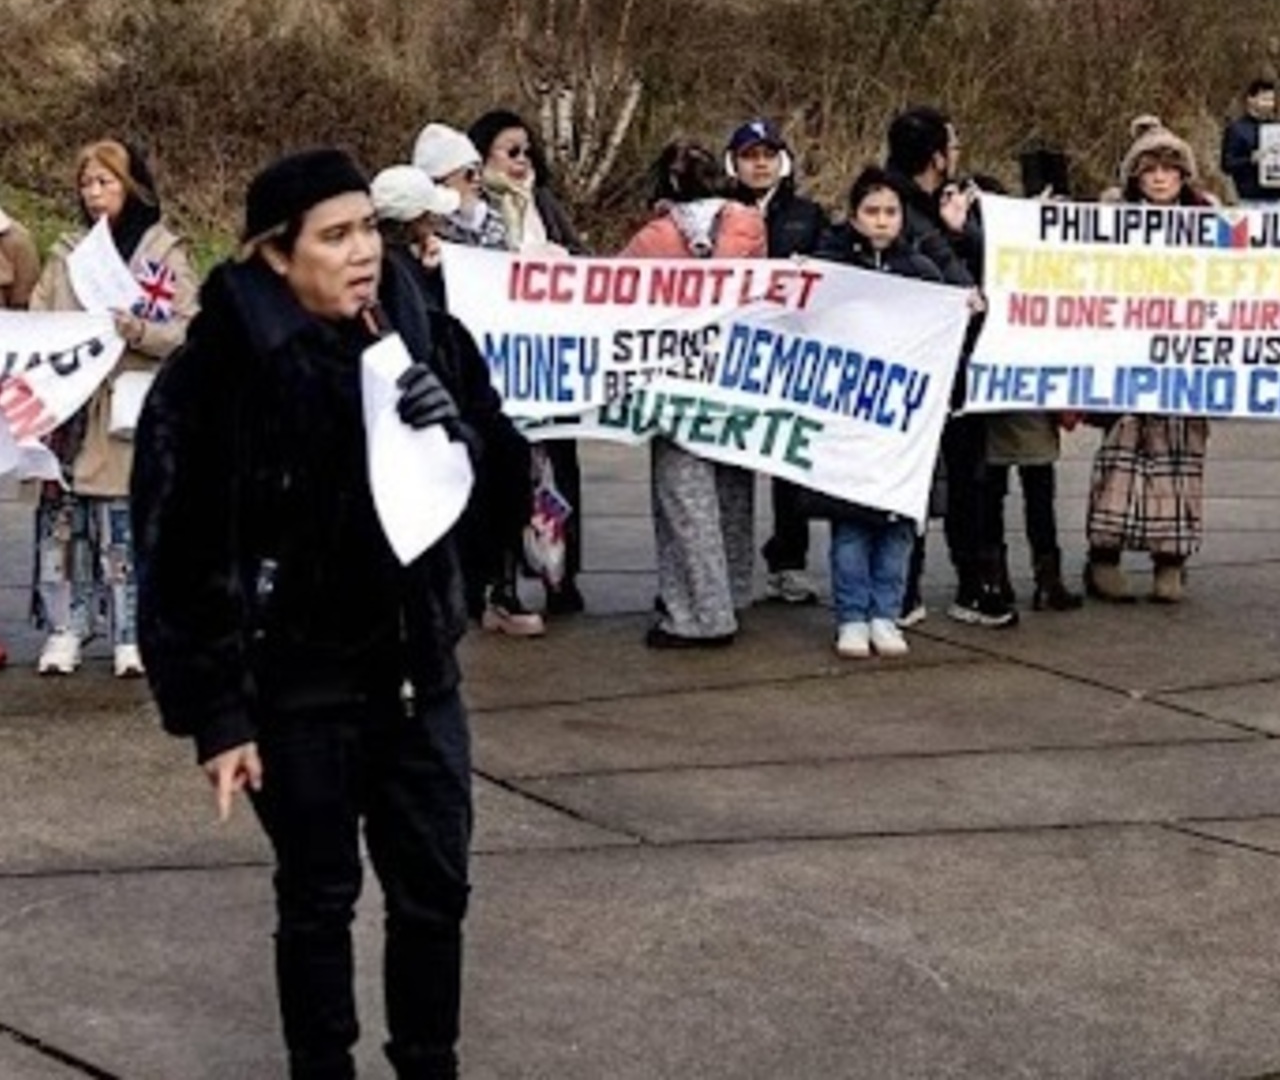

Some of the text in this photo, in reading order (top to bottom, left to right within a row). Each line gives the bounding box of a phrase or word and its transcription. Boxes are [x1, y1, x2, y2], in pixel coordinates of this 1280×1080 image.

[1039, 205, 1217, 247] PHILIPPINE
[509, 261, 823, 309] ICC DO NOT LET
[995, 246, 1196, 294] FUNCTIONS
[1007, 293, 1049, 328] NO
[1055, 296, 1118, 330] ONE
[1149, 334, 1235, 366] OVER
[484, 332, 600, 403] MONEY
[719, 322, 930, 432] DEMOCRACY
[598, 388, 825, 469] DUTERTE
